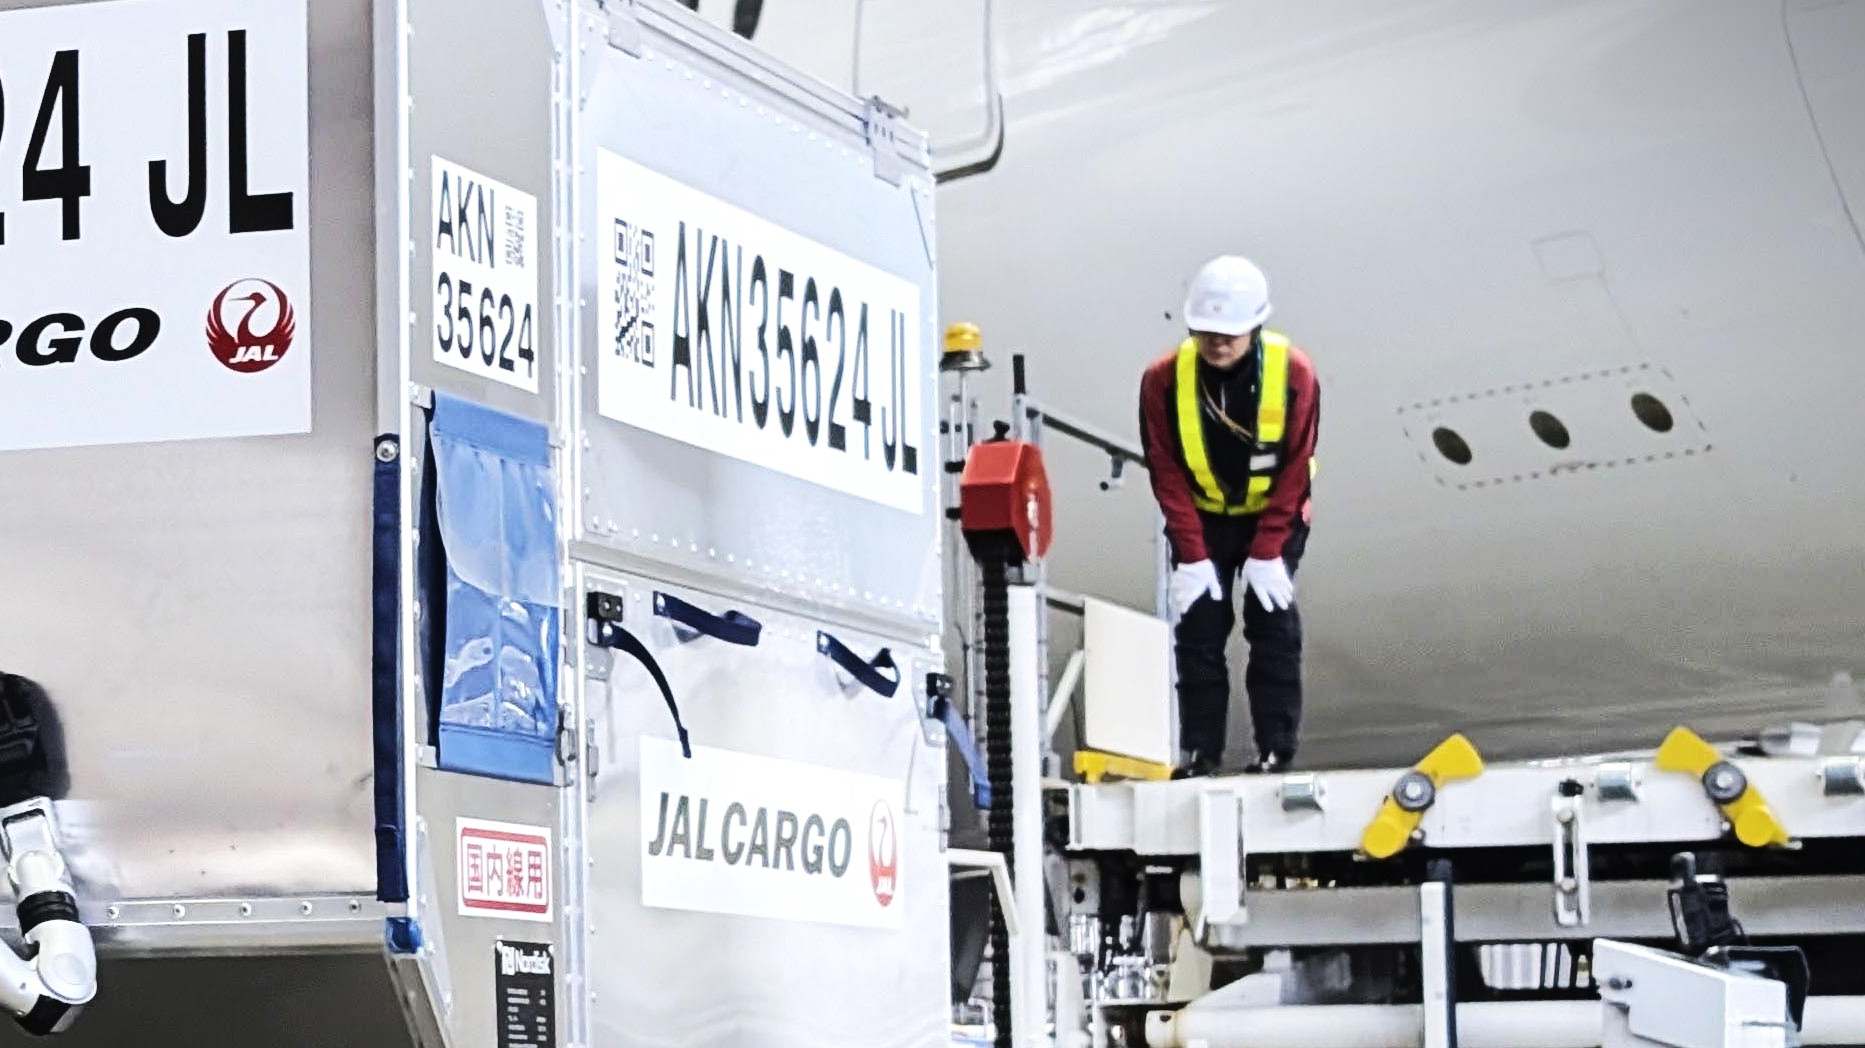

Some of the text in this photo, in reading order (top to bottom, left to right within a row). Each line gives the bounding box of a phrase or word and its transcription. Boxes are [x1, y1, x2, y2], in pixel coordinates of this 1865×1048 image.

[148, 29, 294, 238] JL
[437, 169, 495, 269] AKN
[228, 344, 280, 364] JAL
[437, 271, 535, 379] 35624
[466, 843, 543, 899] 国内線用
[721, 801, 853, 879] CARGO
